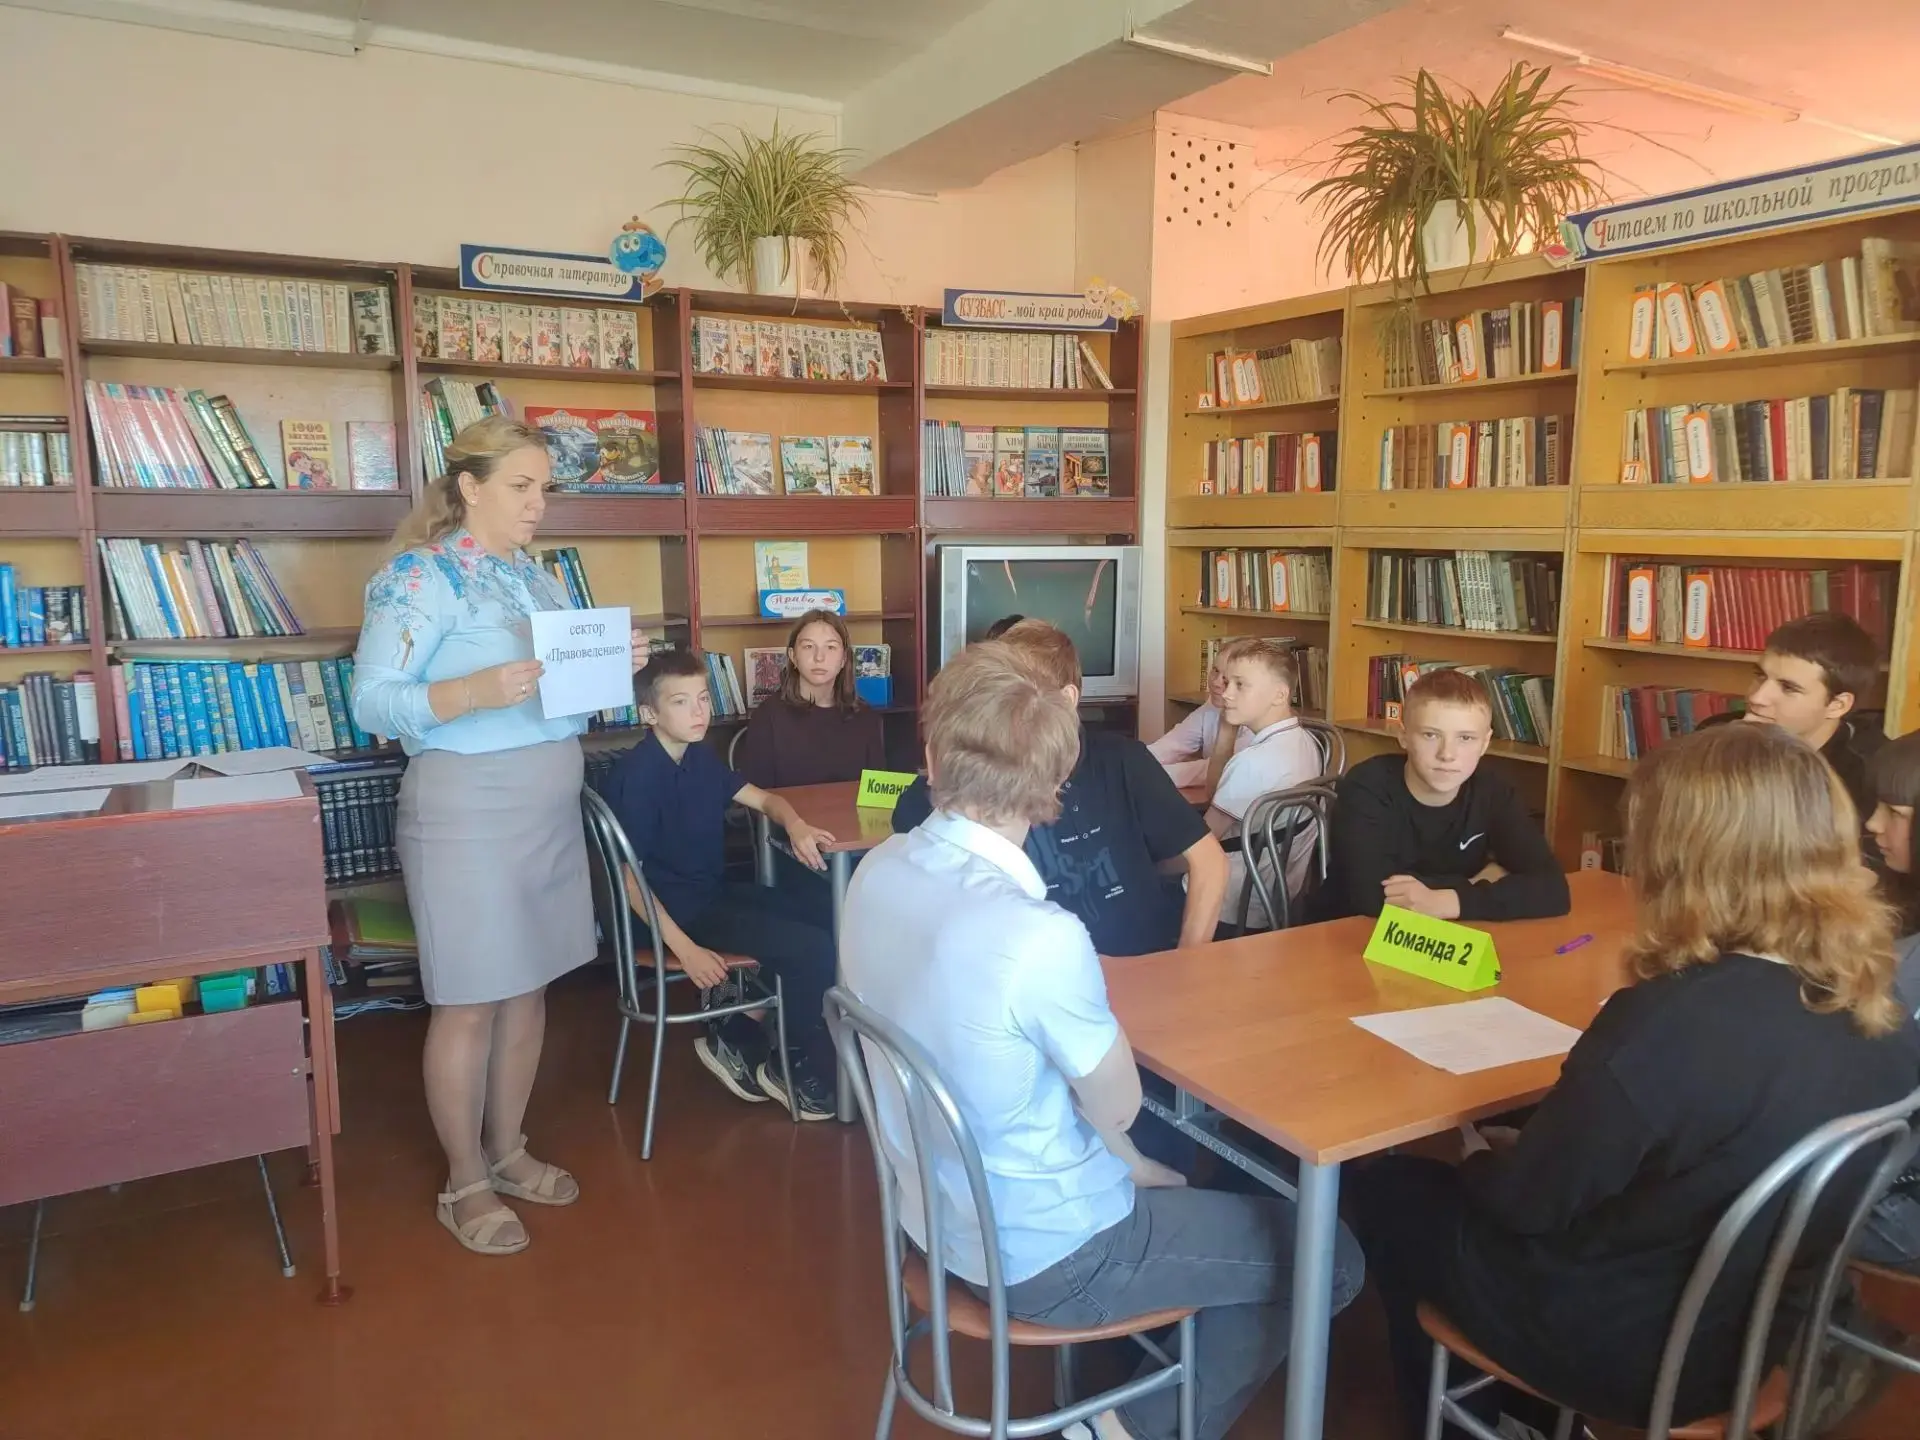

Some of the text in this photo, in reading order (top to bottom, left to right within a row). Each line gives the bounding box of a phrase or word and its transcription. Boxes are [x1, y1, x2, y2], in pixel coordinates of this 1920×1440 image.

[1592, 214, 1668, 248] Читаем
[1672, 208, 1695, 236] по
[1703, 177, 1814, 225] школьной
[478, 254, 628, 287] Справочная литература
[959, 297, 1006, 318] КУЗБАСС
[1014, 302, 1036, 318] мой
[1038, 304, 1065, 320] край
[1066, 304, 1104, 321] родной
[1200, 395, 1210, 407] А
[569, 623, 606, 637] сектор
[545, 644, 626, 666] «Правоведение»
[1383, 920, 1473, 966] Команда 2
